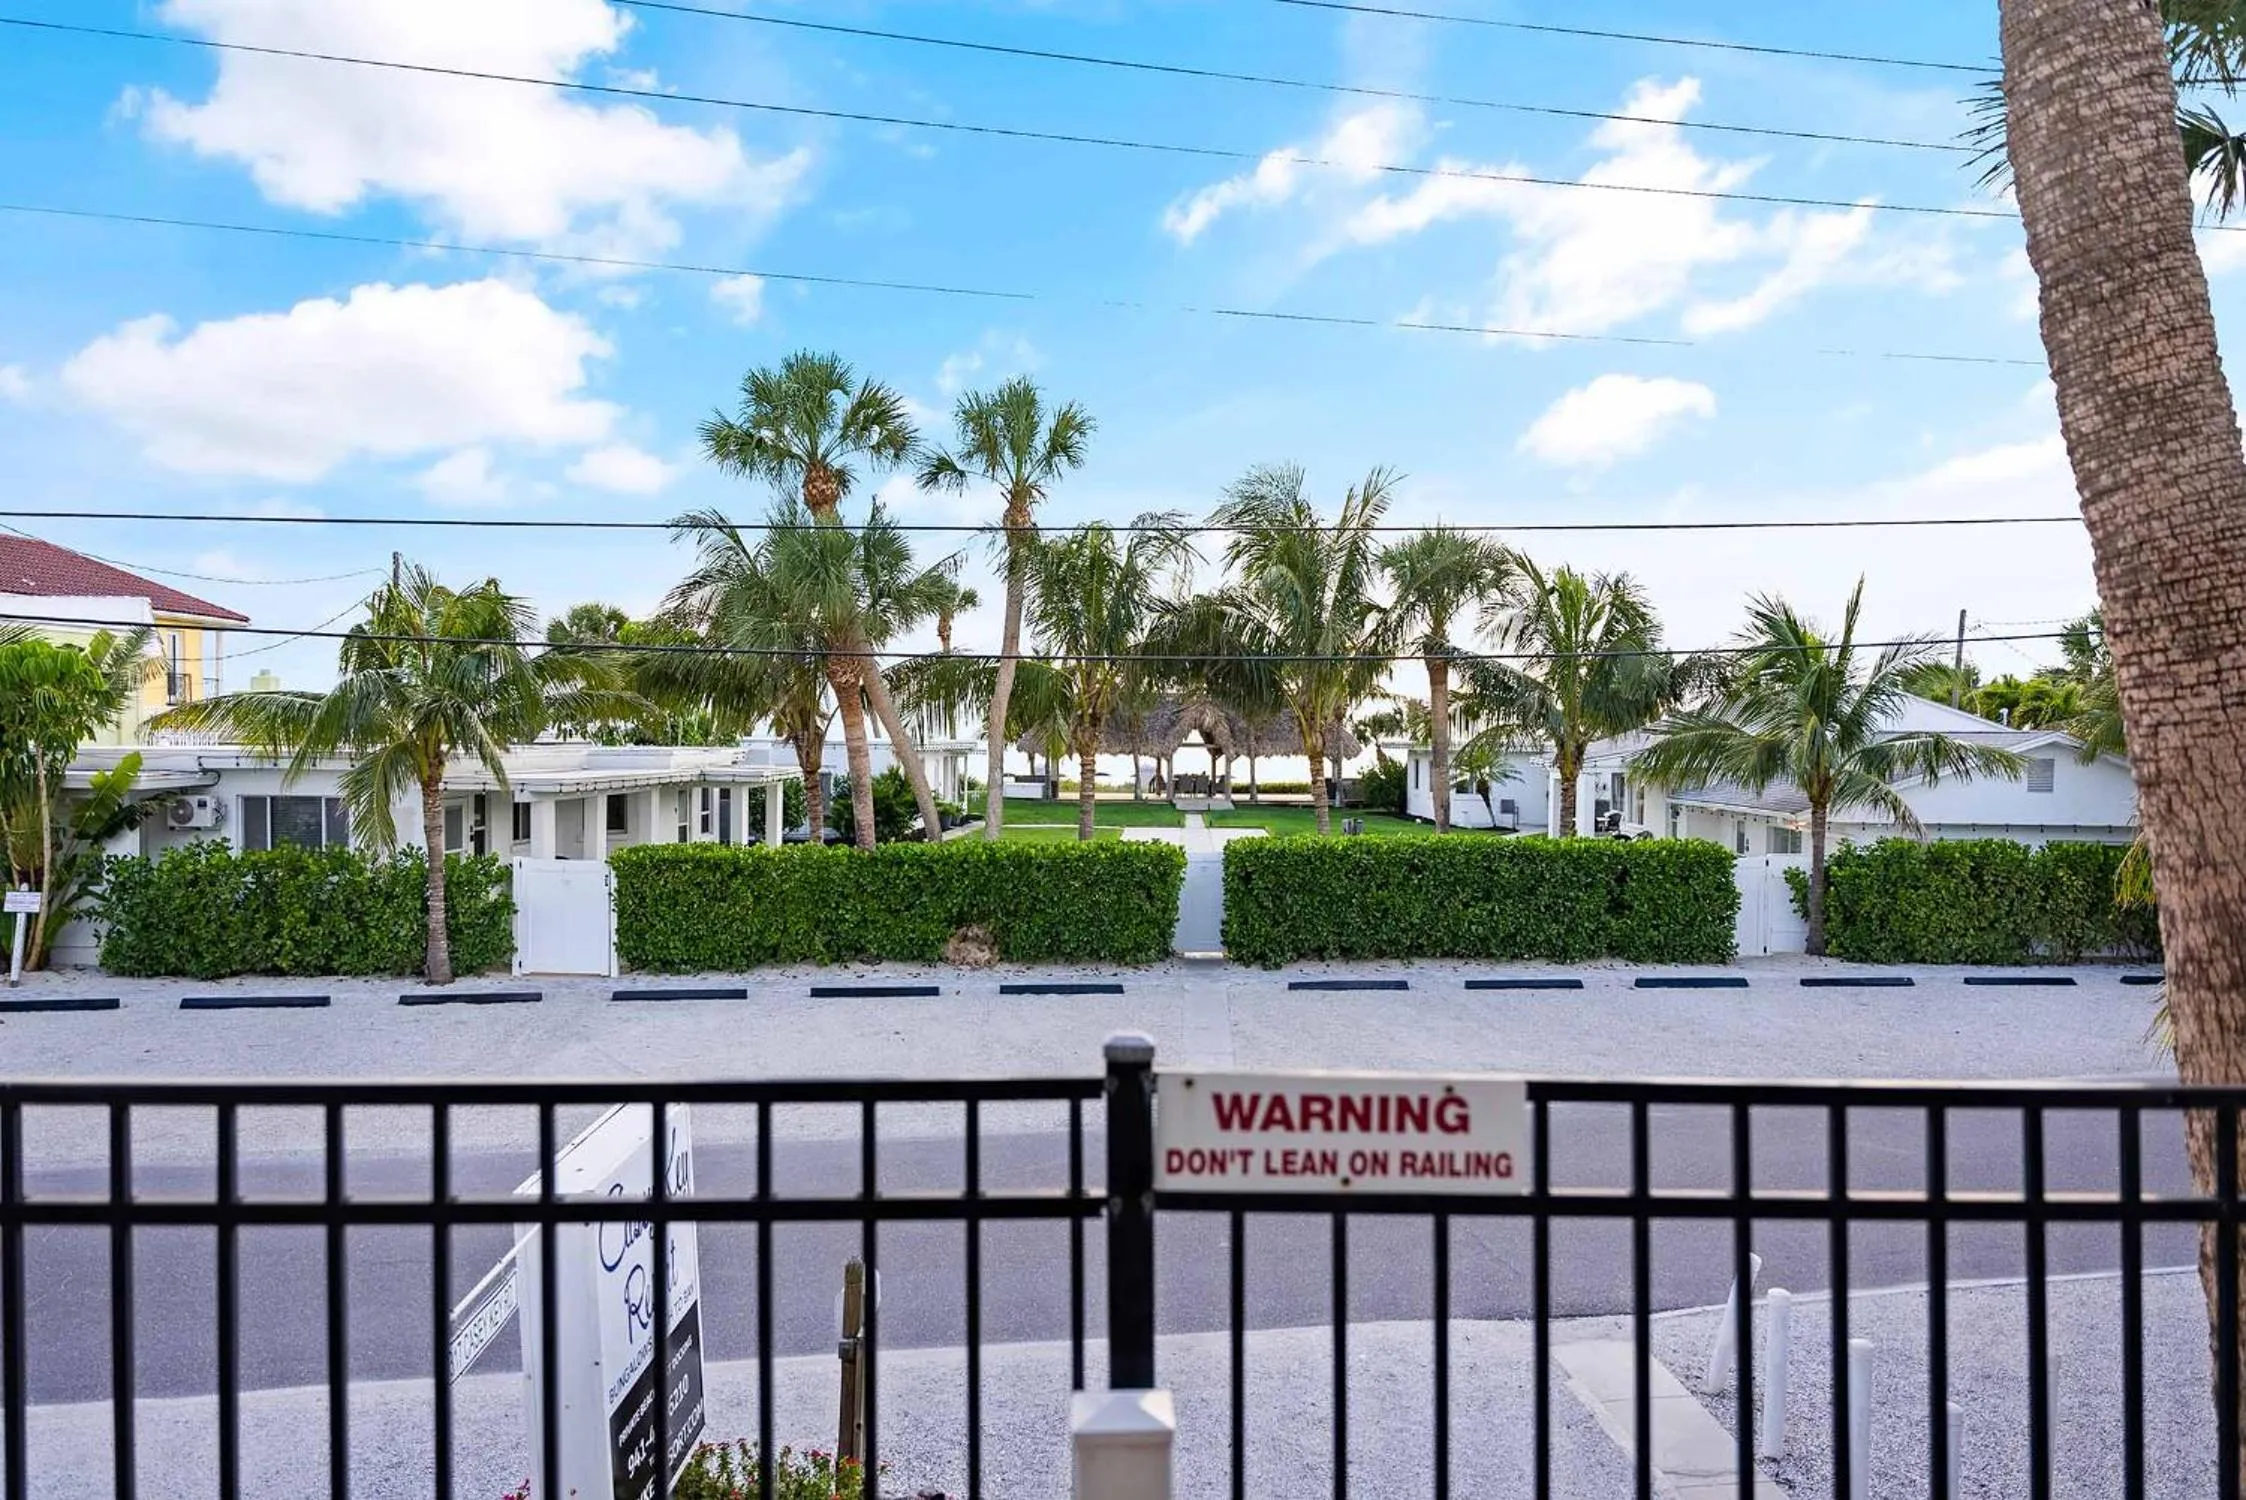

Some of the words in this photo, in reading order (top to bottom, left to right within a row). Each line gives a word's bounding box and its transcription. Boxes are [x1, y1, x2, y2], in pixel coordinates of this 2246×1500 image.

[1212, 1092, 1470, 1134] WARNING
[1165, 1148, 1254, 1176] DON'T
[1264, 1149, 1338, 1176] LEAN
[1348, 1150, 1389, 1177] ON
[1399, 1151, 1514, 1179] RAILING
[608, 1335, 653, 1405] BUNGALOWS
